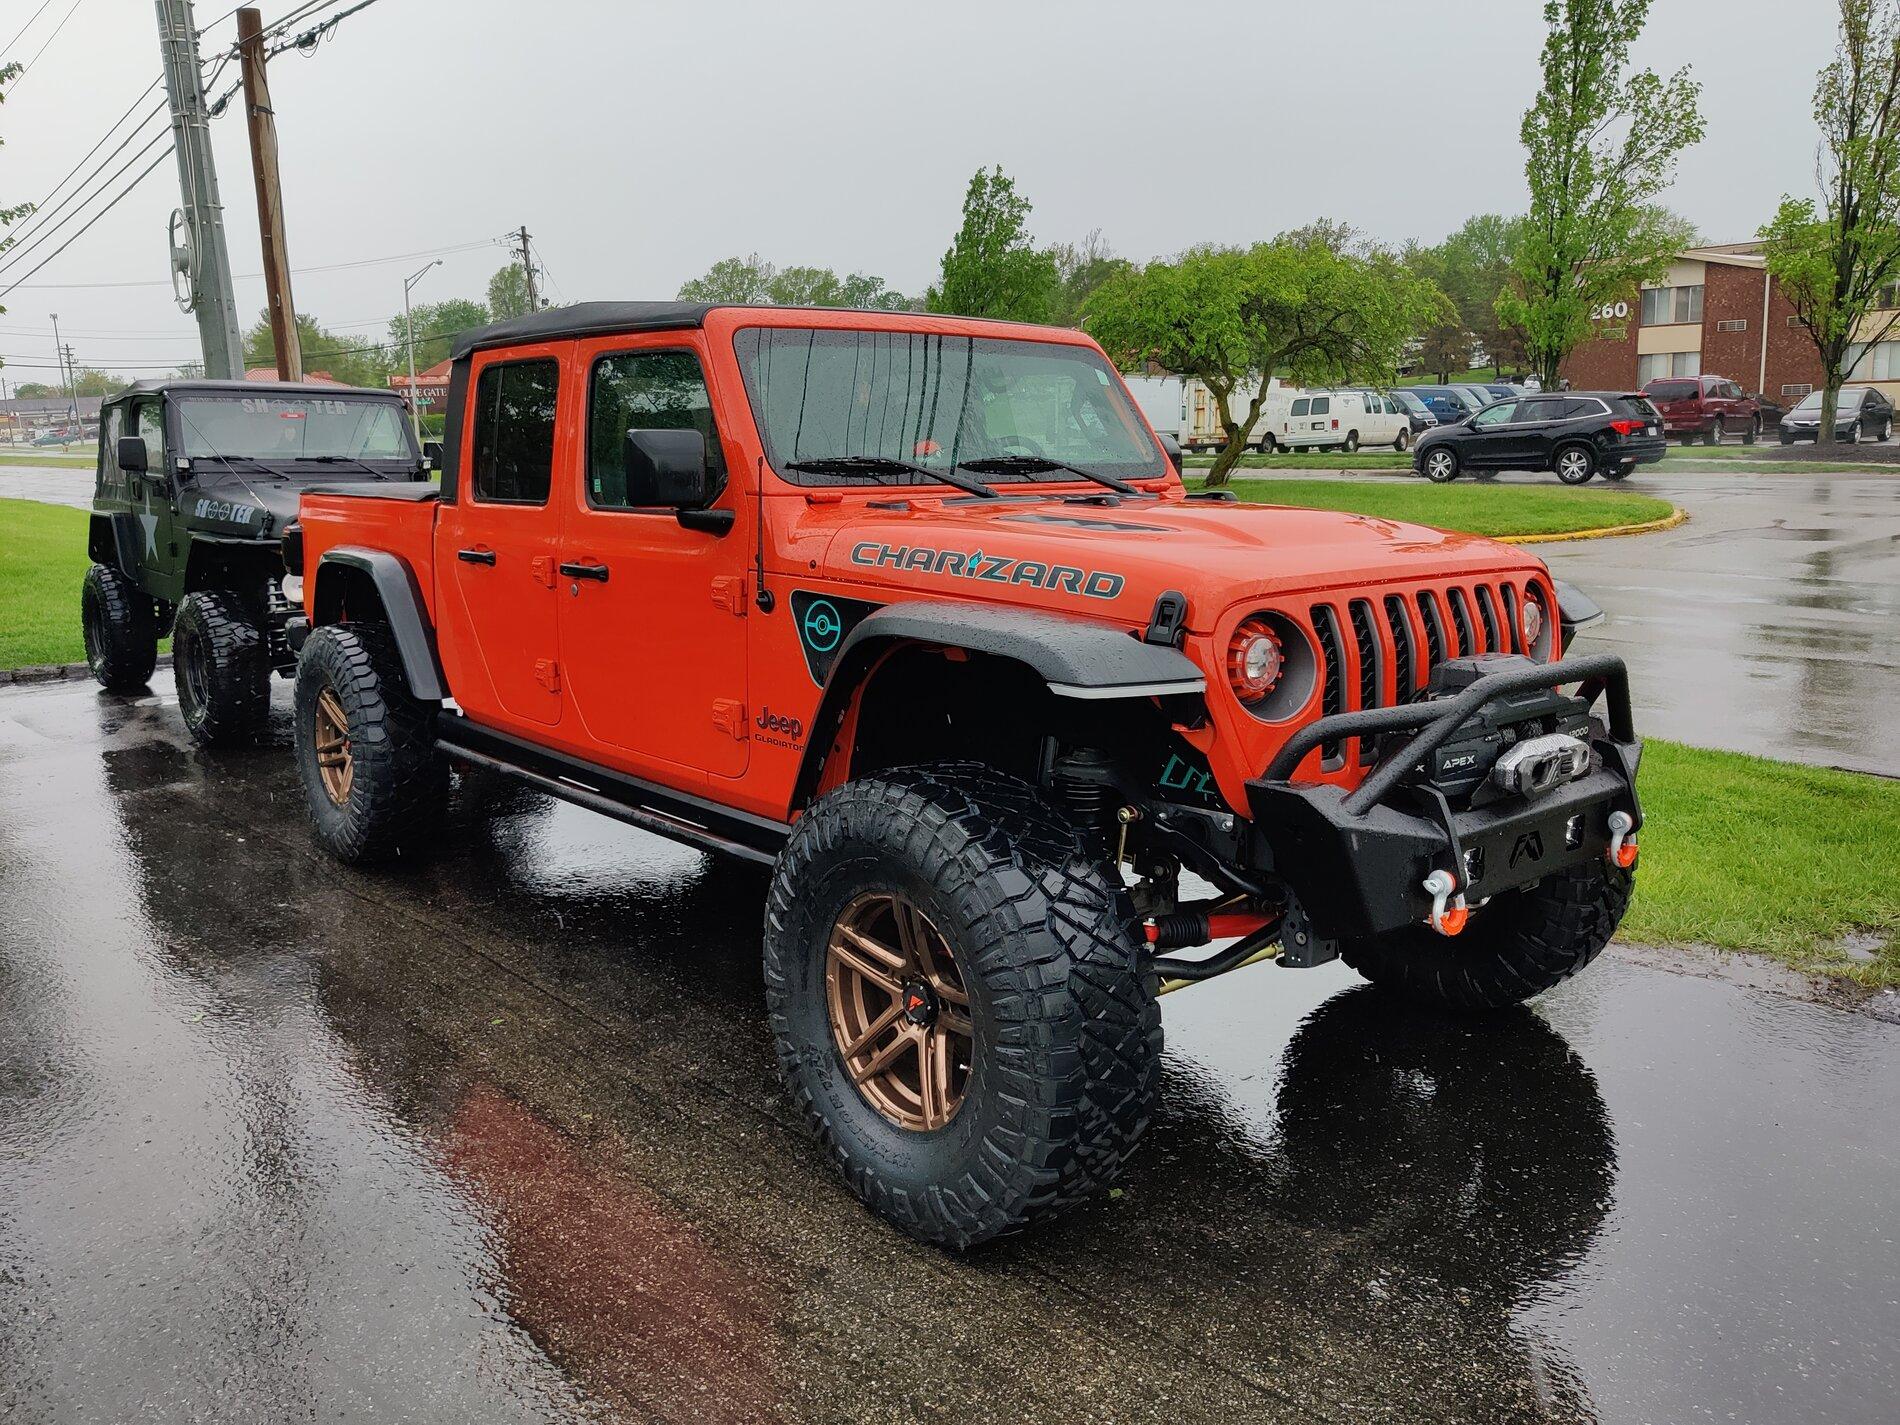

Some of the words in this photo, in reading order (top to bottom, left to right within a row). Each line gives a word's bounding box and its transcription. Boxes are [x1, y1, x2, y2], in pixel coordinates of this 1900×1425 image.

[1590, 301, 1628, 320] 260
[399, 388, 422, 398] OLE
[424, 387, 447, 397] GATE
[850, 541, 1125, 600] CHARIZARD
[756, 705, 804, 741] Jeep
[1442, 754, 1475, 770] APEX
